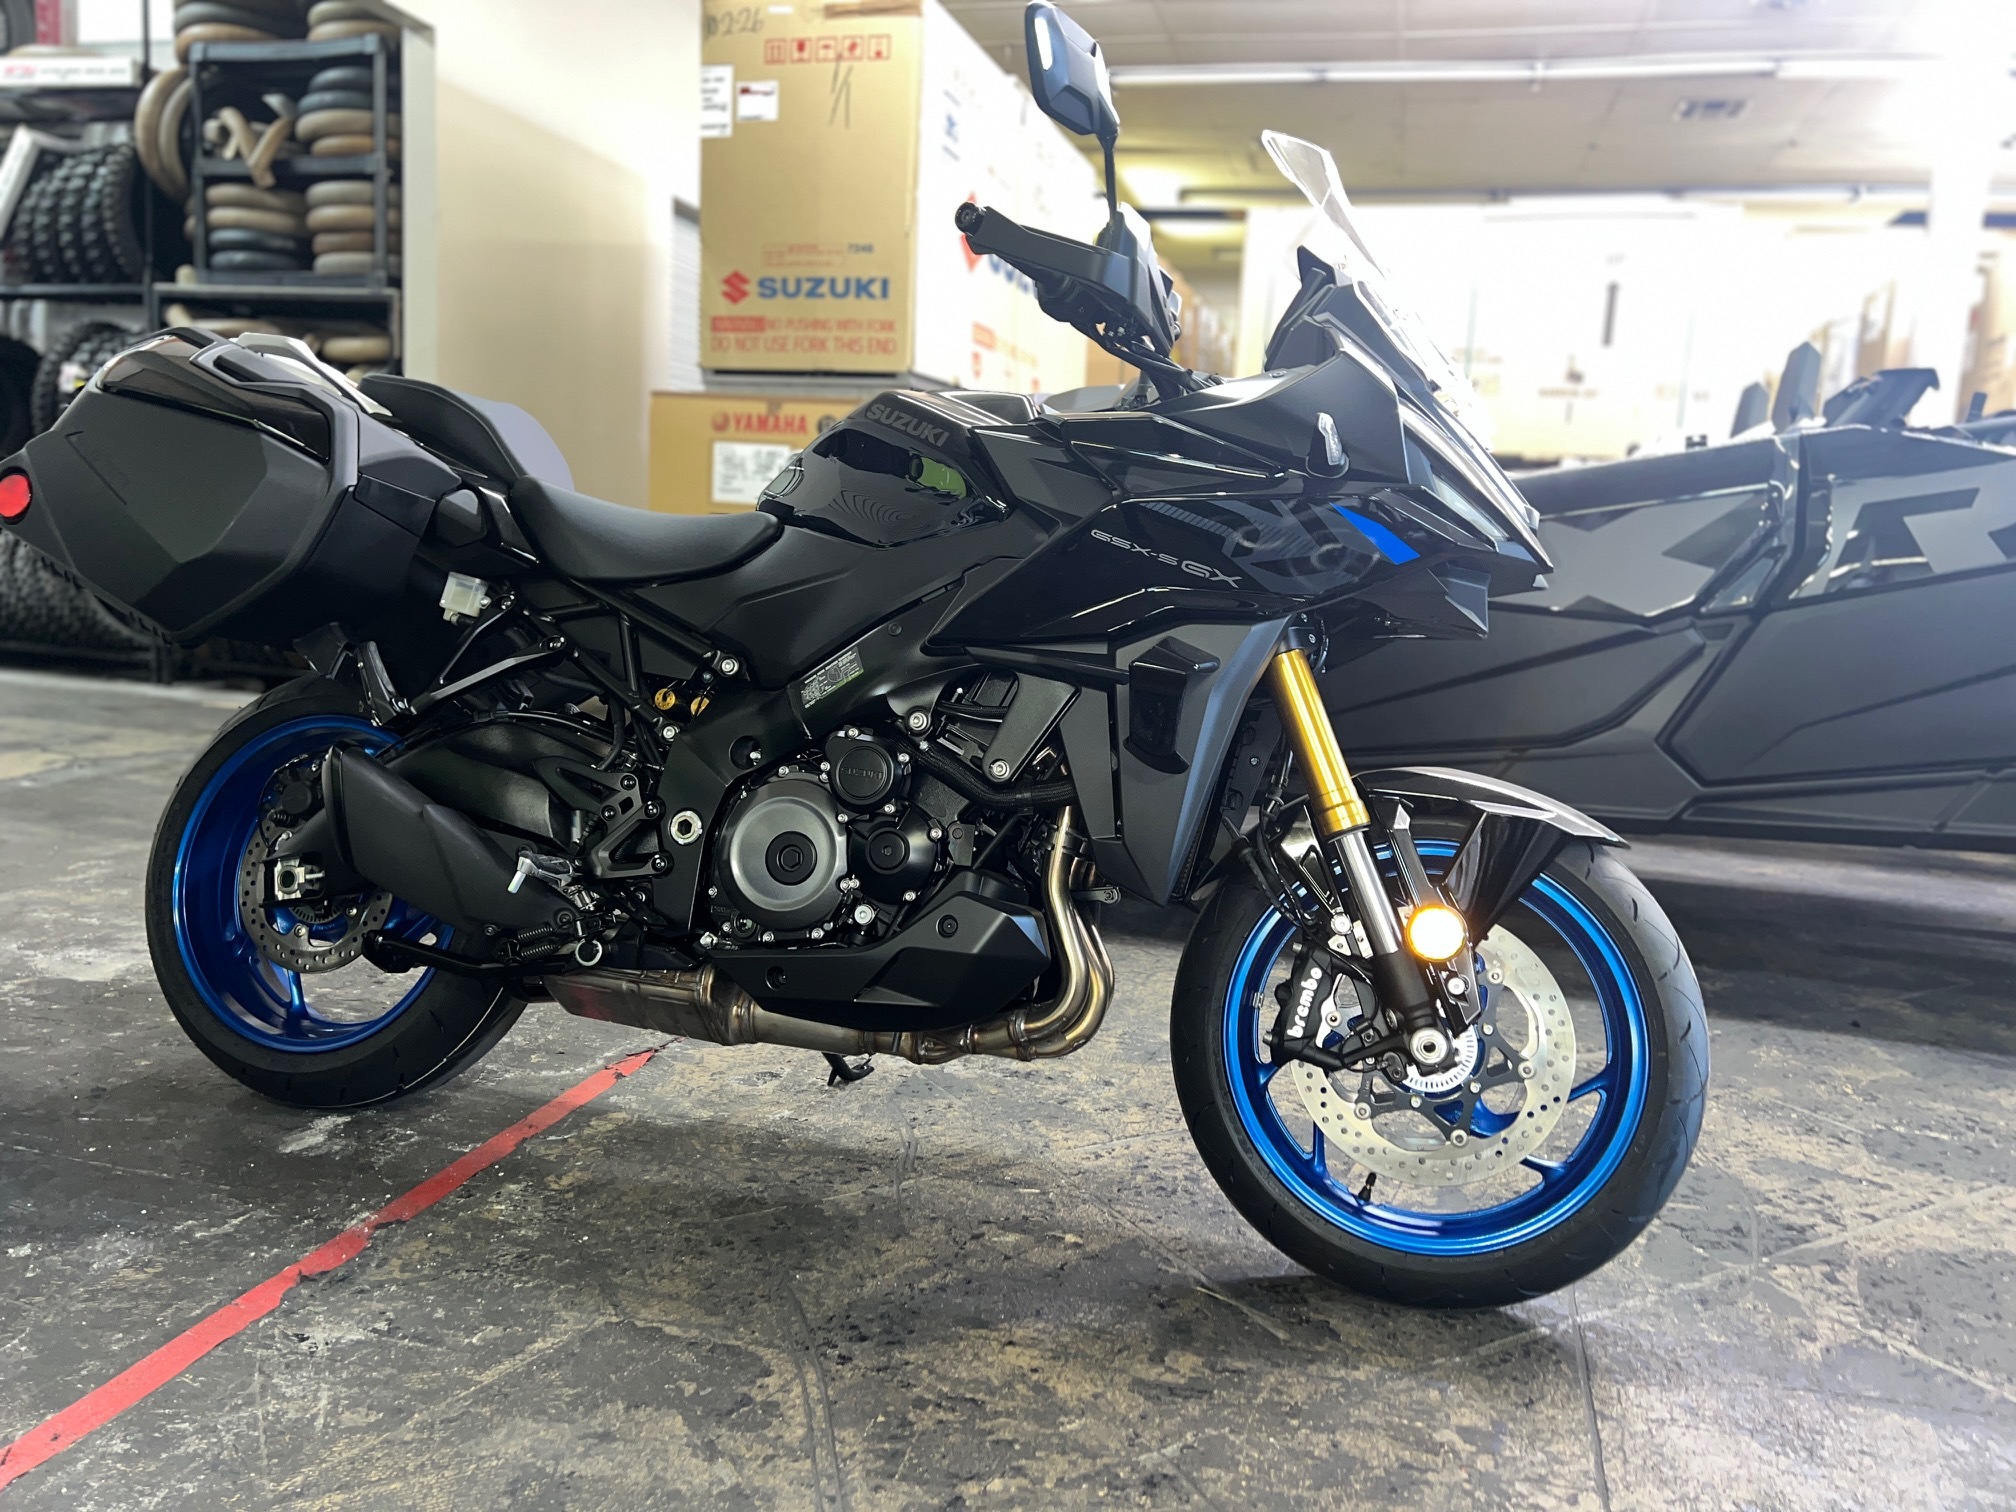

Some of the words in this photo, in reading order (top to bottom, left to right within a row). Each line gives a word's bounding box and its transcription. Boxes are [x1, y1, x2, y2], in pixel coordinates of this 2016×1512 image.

[757, 276, 890, 300] SUZUKI
[735, 335, 761, 353] NOT
[764, 335, 789, 354] USE
[794, 335, 829, 354] FORK
[834, 336, 865, 355] THIS
[867, 337, 898, 356] END
[733, 411, 808, 435] YAMAHA
[866, 403, 951, 448] SUZUKI
[1091, 529, 1179, 566] GSX-S
[1181, 560, 1242, 589] GX
[1286, 967, 1322, 1038] brembo
